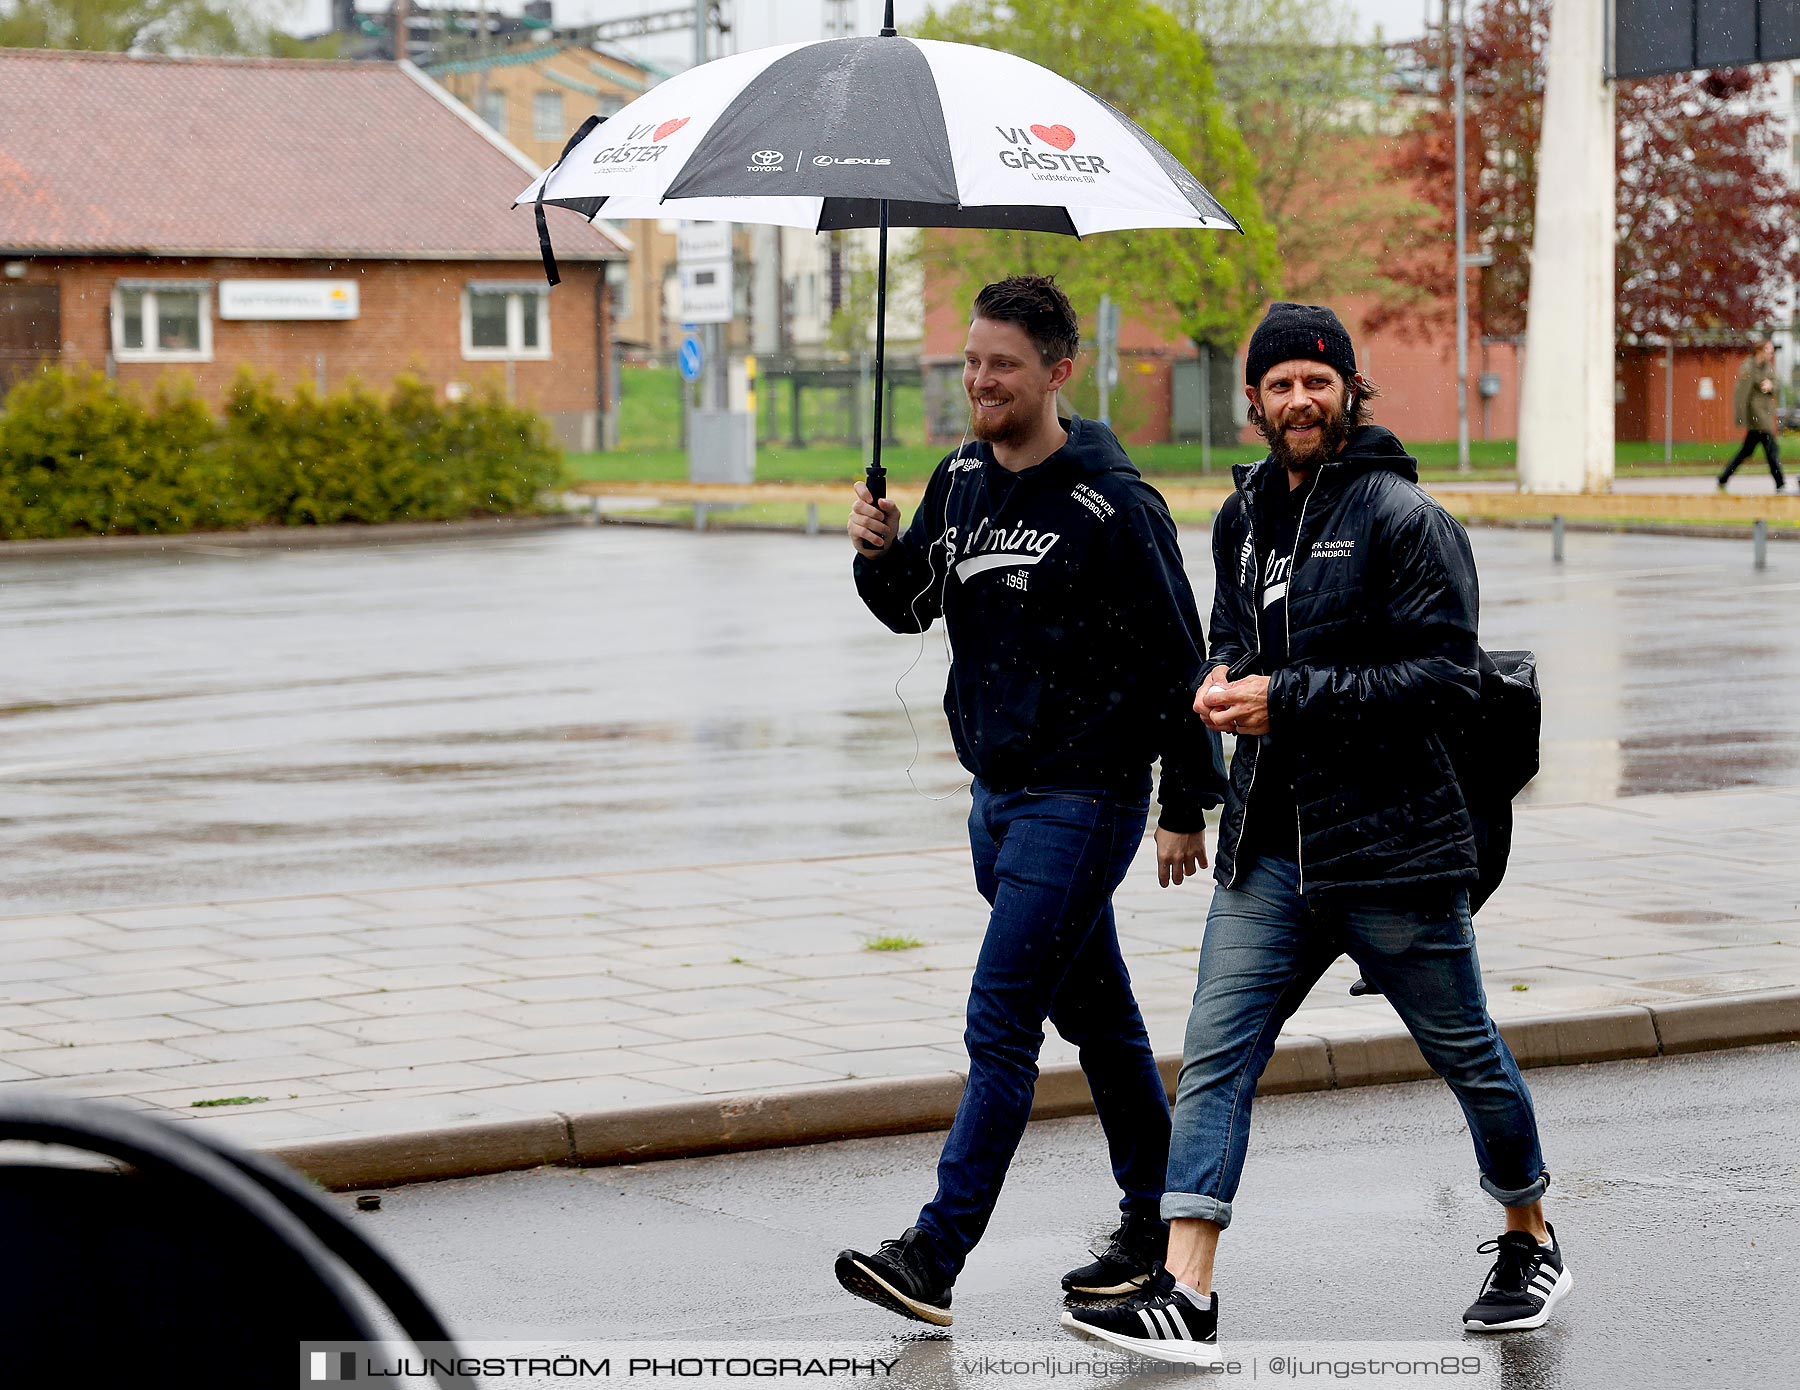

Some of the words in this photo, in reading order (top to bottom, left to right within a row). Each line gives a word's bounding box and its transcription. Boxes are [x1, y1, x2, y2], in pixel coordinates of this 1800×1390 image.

[627, 124, 656, 140] VI
[995, 125, 1032, 145] VI
[593, 142, 668, 164] GÄSTER
[834, 157, 892, 166] LEXUS
[999, 146, 1111, 174] GÄSTER
[1031, 172, 1083, 183] Lindströms
[1083, 175, 1096, 184] Bil
[1070, 489, 1106, 523] HANDBOLL
[1087, 489, 1116, 517] SKÖVDE
[945, 516, 1060, 567] Slming
[1311, 549, 1352, 558] HANDBOLL
[1006, 573, 1028, 592] 1991
